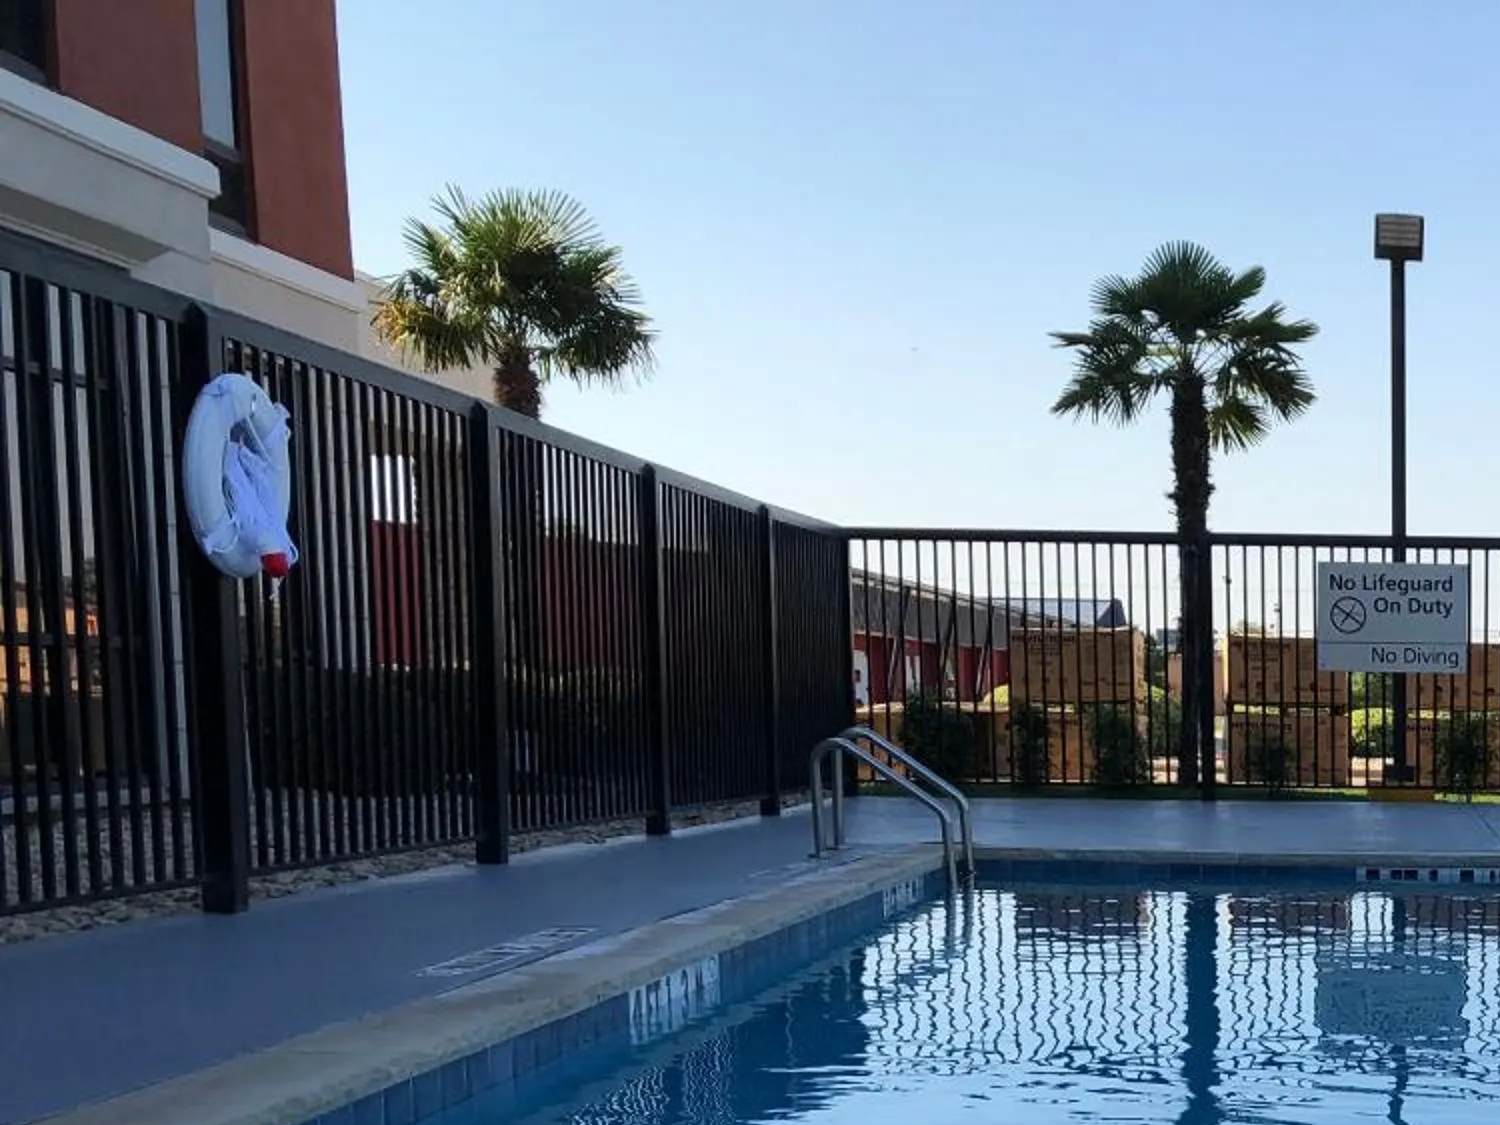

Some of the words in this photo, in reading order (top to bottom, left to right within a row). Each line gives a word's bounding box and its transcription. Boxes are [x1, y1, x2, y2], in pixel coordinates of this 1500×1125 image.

[1329, 574, 1356, 591] No
[1362, 574, 1453, 596] Lifeguard
[1373, 597, 1401, 614] On
[1408, 598, 1453, 619] Duty
[1371, 647, 1397, 664] No
[1403, 648, 1459, 669] Diving
